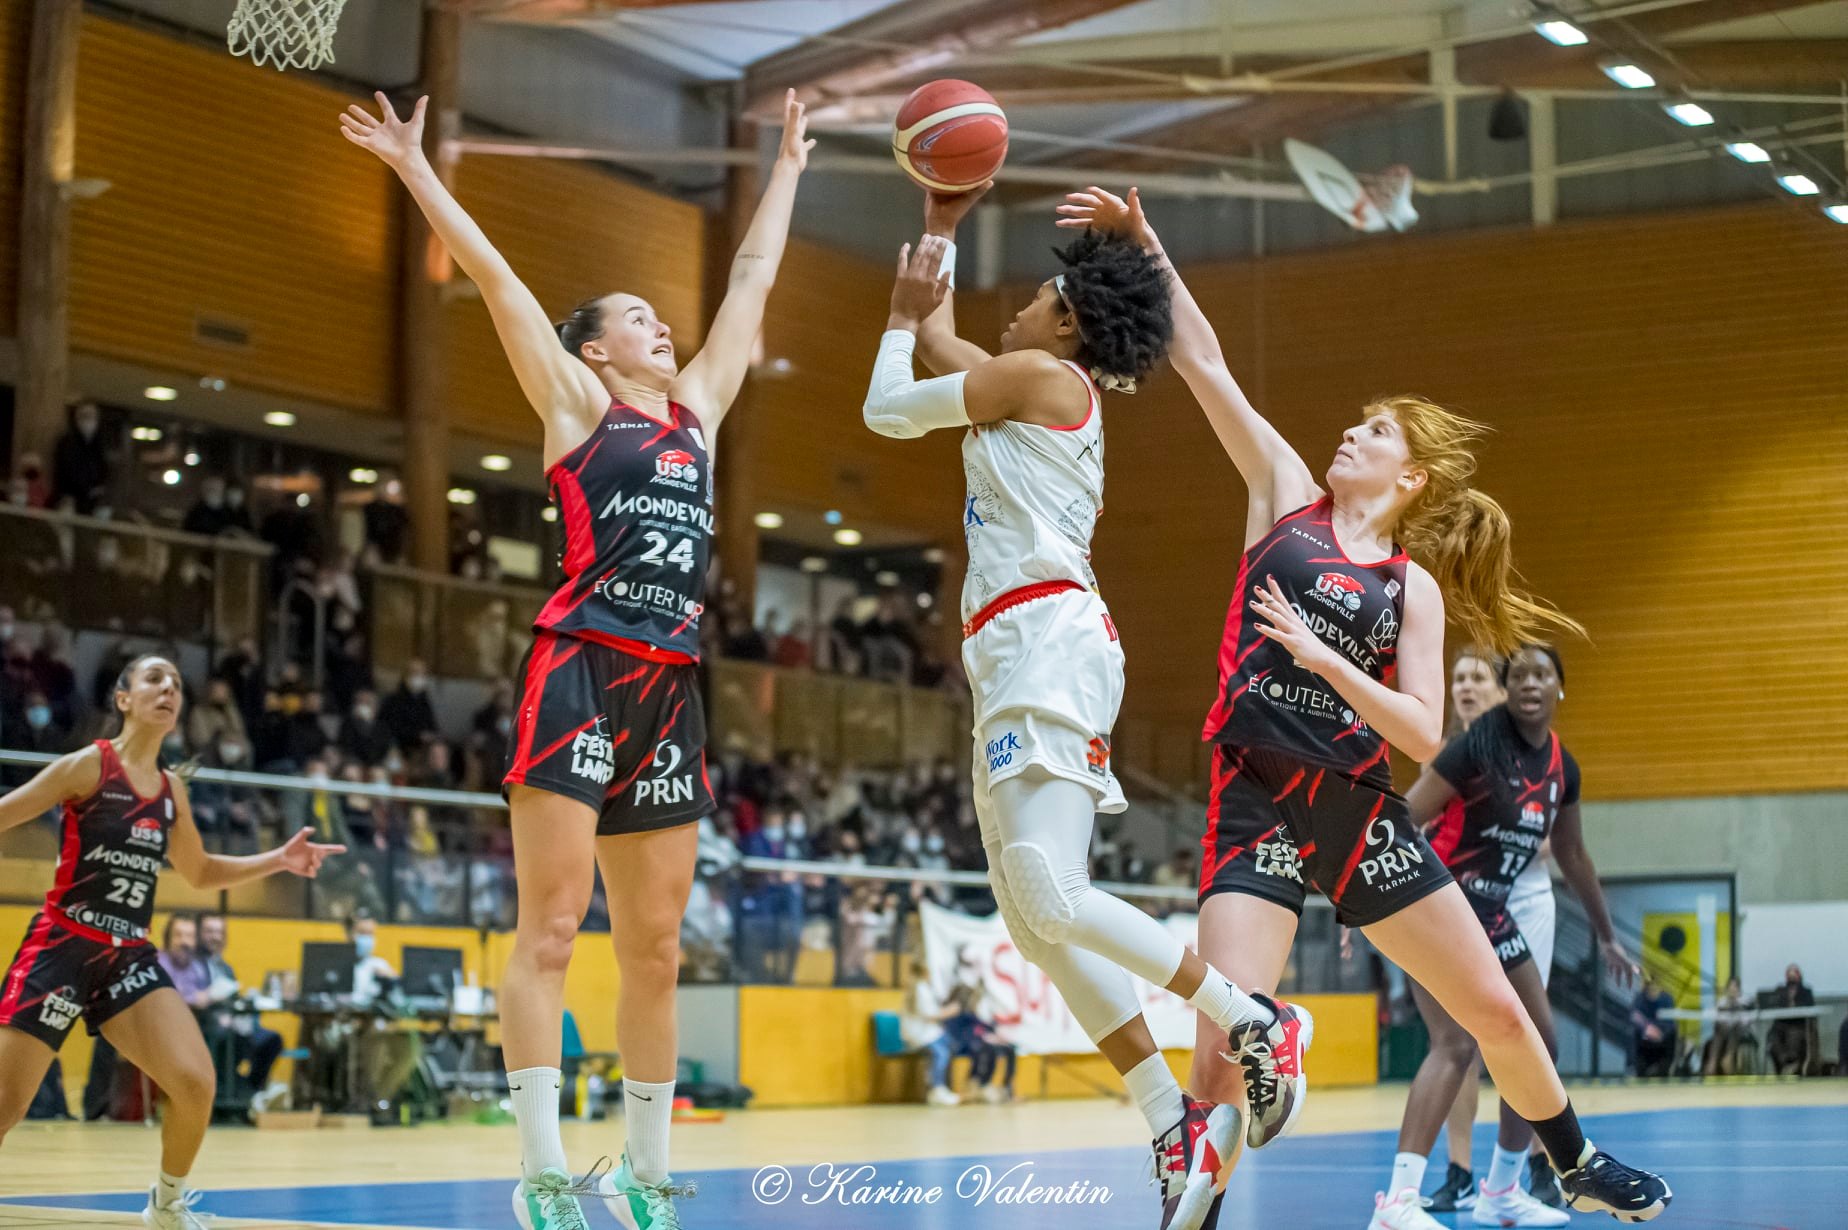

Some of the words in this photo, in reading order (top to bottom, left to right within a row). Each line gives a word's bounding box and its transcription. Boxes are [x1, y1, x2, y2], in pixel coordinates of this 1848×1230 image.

[606, 422, 651, 431] TARMAK
[639, 530, 695, 573] 24
[1290, 526, 1331, 551] TARMAK
[1303, 588, 1356, 622] MONDEVILLE
[1291, 602, 1378, 672] ONDEVILLE
[1270, 700, 1298, 713] OPTIQUE
[1306, 708, 1337, 721] AUDITION
[633, 774, 694, 807] PRN
[1358, 842, 1424, 885] PRN
[105, 876, 150, 909] 25
[1377, 869, 1421, 893] TARMAK
[108, 965, 159, 1000] PRN
